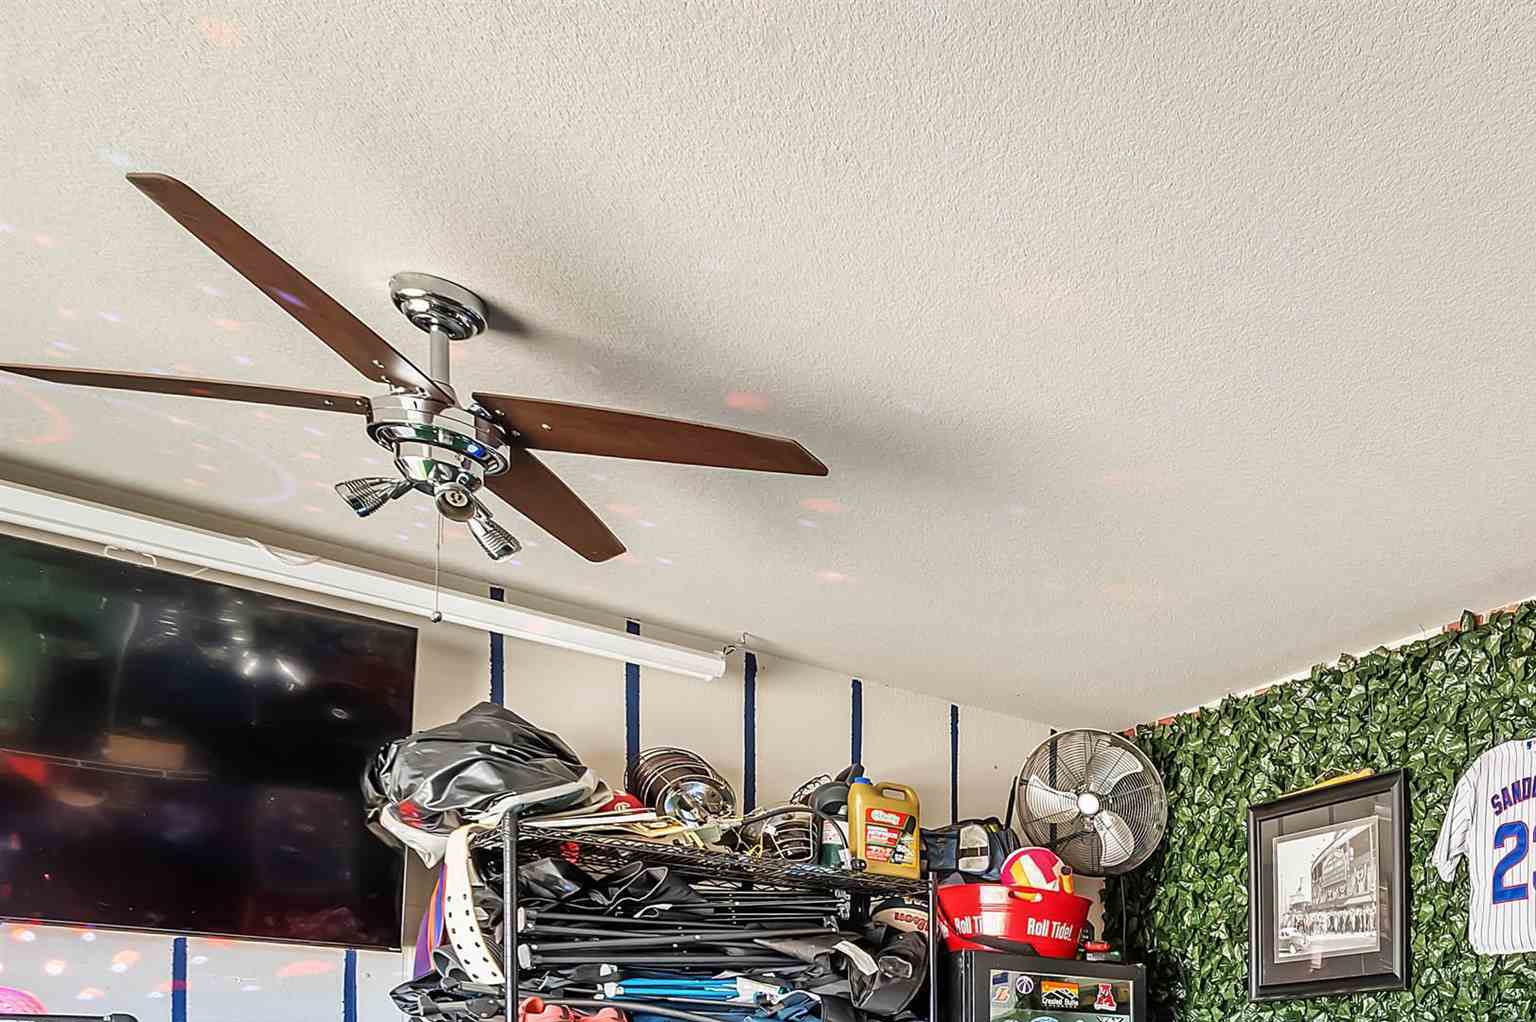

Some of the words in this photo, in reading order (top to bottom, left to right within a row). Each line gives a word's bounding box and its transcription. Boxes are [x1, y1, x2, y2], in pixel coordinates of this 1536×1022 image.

[954, 915, 972, 935] Roll
[1027, 917, 1049, 937] Roll
[1051, 920, 1073, 941] Tide!
